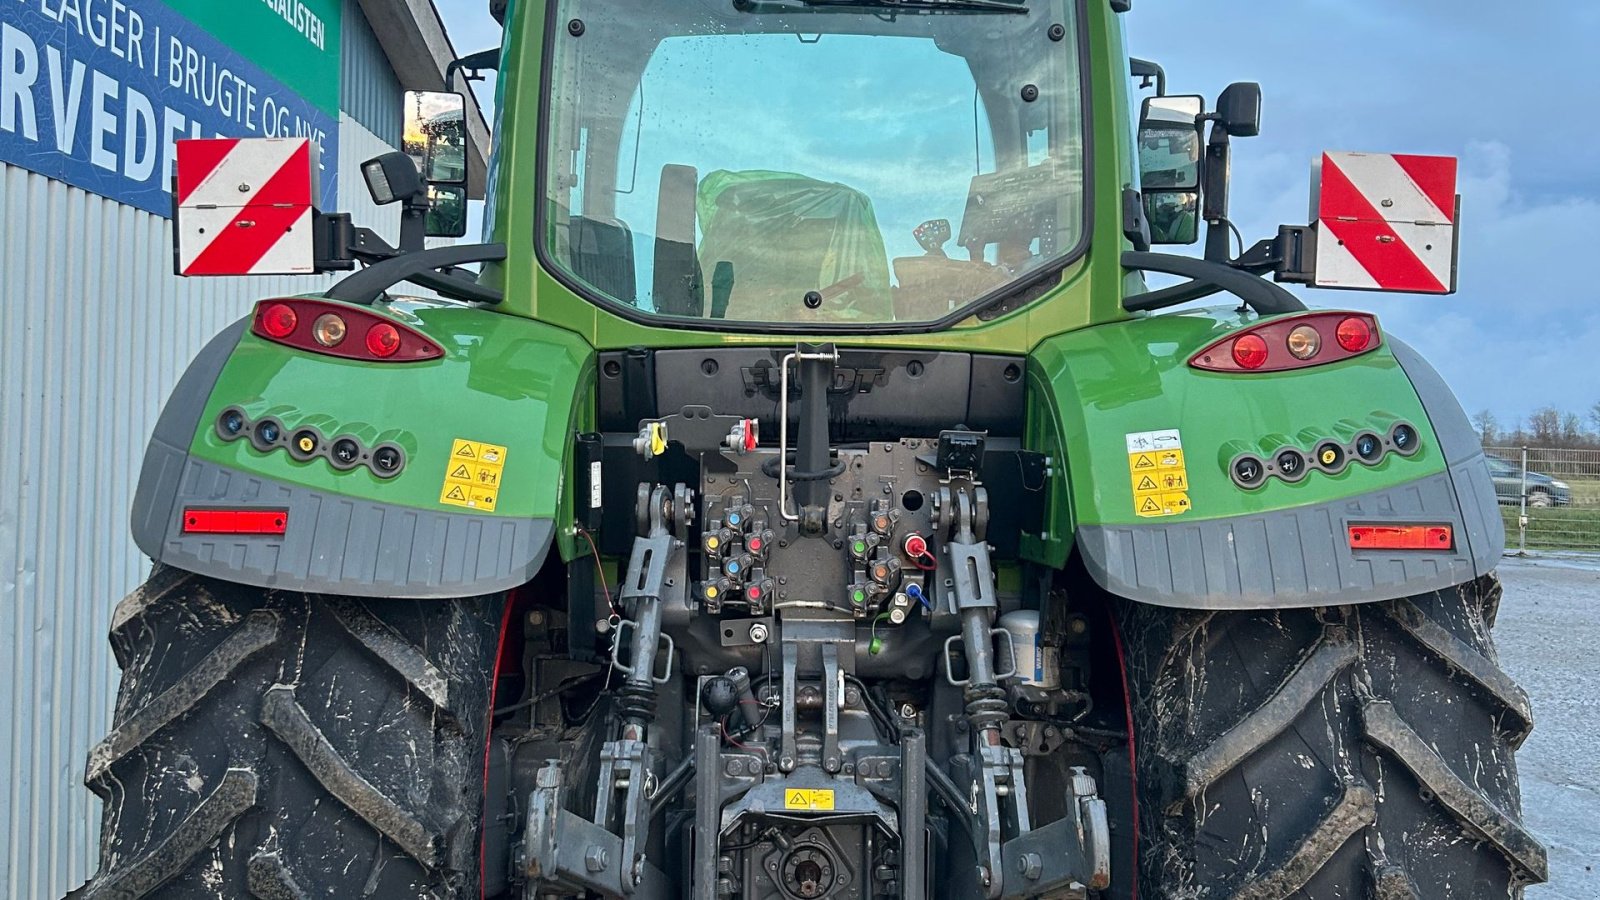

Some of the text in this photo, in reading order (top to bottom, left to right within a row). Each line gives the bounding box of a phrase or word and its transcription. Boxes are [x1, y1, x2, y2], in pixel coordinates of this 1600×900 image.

[153, 26, 160, 77] I
[169, 35, 256, 131] BRUGTE
[262, 97, 290, 138] OG
